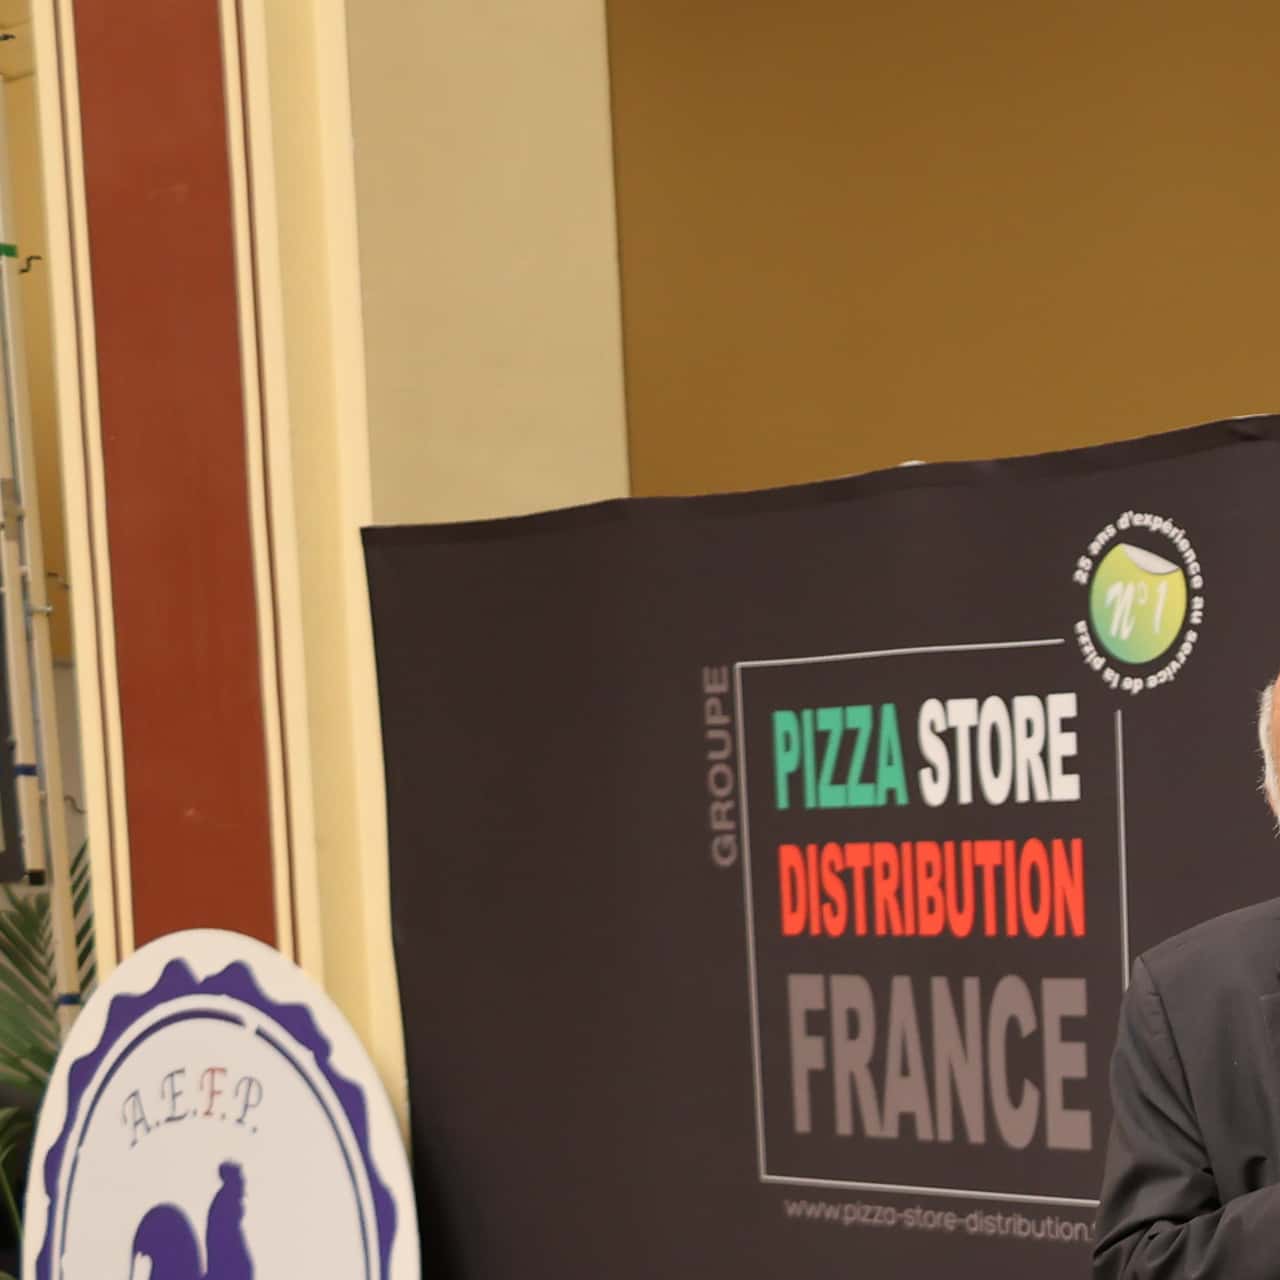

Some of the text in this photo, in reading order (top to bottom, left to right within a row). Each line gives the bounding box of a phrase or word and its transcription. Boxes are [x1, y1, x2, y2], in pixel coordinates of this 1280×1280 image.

[1088, 524, 1117, 556] ans
[1190, 596, 1204, 624] au
[1074, 620, 1106, 671] pizza
[1146, 629, 1198, 689] service
[1120, 676, 1144, 696] de
[703, 666, 737, 867] GROUPE
[772, 692, 1081, 810] PIZZA STORE
[778, 838, 1085, 937] DISTRIBUTION
[788, 973, 1093, 1150] FRANCE
